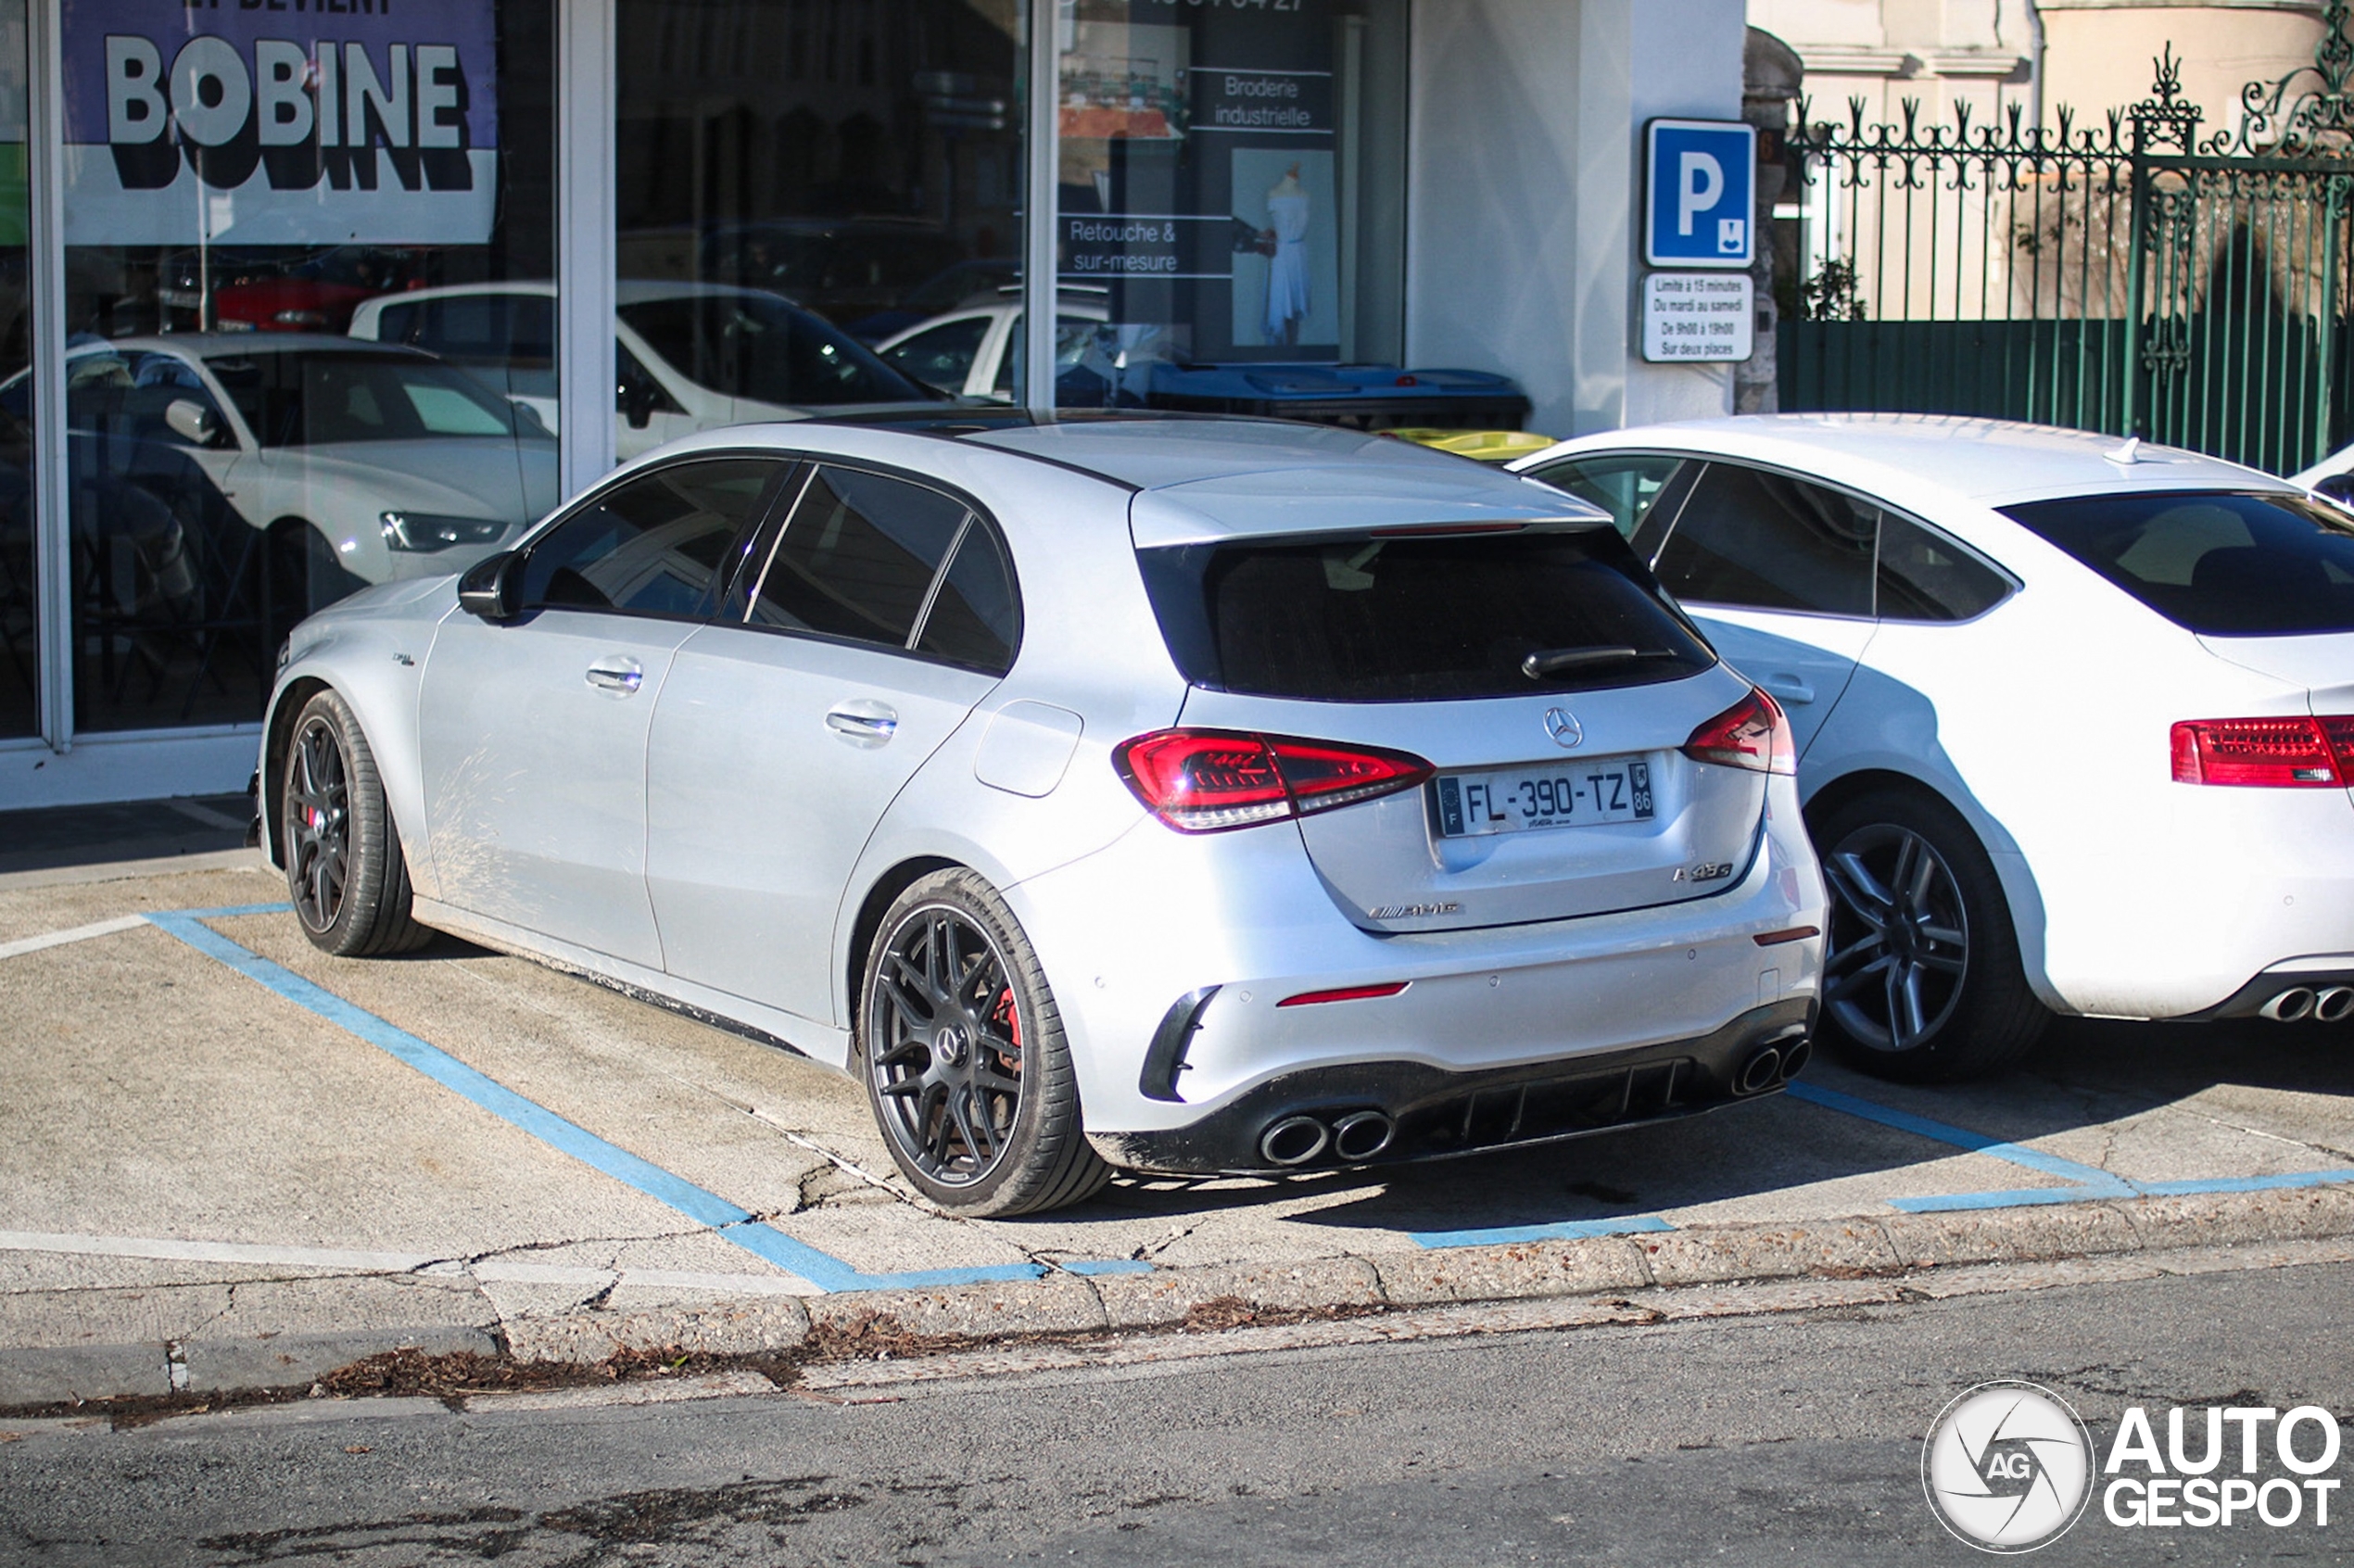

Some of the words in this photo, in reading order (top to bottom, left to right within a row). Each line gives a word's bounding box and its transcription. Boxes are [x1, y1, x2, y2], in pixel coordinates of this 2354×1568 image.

[104, 34, 462, 150] BOBINE
[1224, 76, 1298, 98] Broderie
[1215, 104, 1311, 126] industrielle
[1678, 151, 1724, 235] P
[1070, 221, 1158, 242] Retouche
[1162, 222, 1176, 243] &
[1074, 254, 1177, 272] sur-mesure
[1694, 279, 1704, 292] 15
[1706, 280, 1742, 292] minutes
[1654, 298, 1667, 311] Du
[1669, 298, 1695, 311] mardi
[1698, 302, 1708, 311] au
[1711, 298, 1742, 311] samedi
[1662, 322, 1674, 335] De
[1661, 341, 1678, 355] Sur
[1679, 342, 1702, 355] deux
[1704, 341, 1734, 357] places
[1449, 813, 1457, 825] F
[1466, 773, 1627, 823] FL-390-TZ
[1634, 791, 1652, 811] 86
